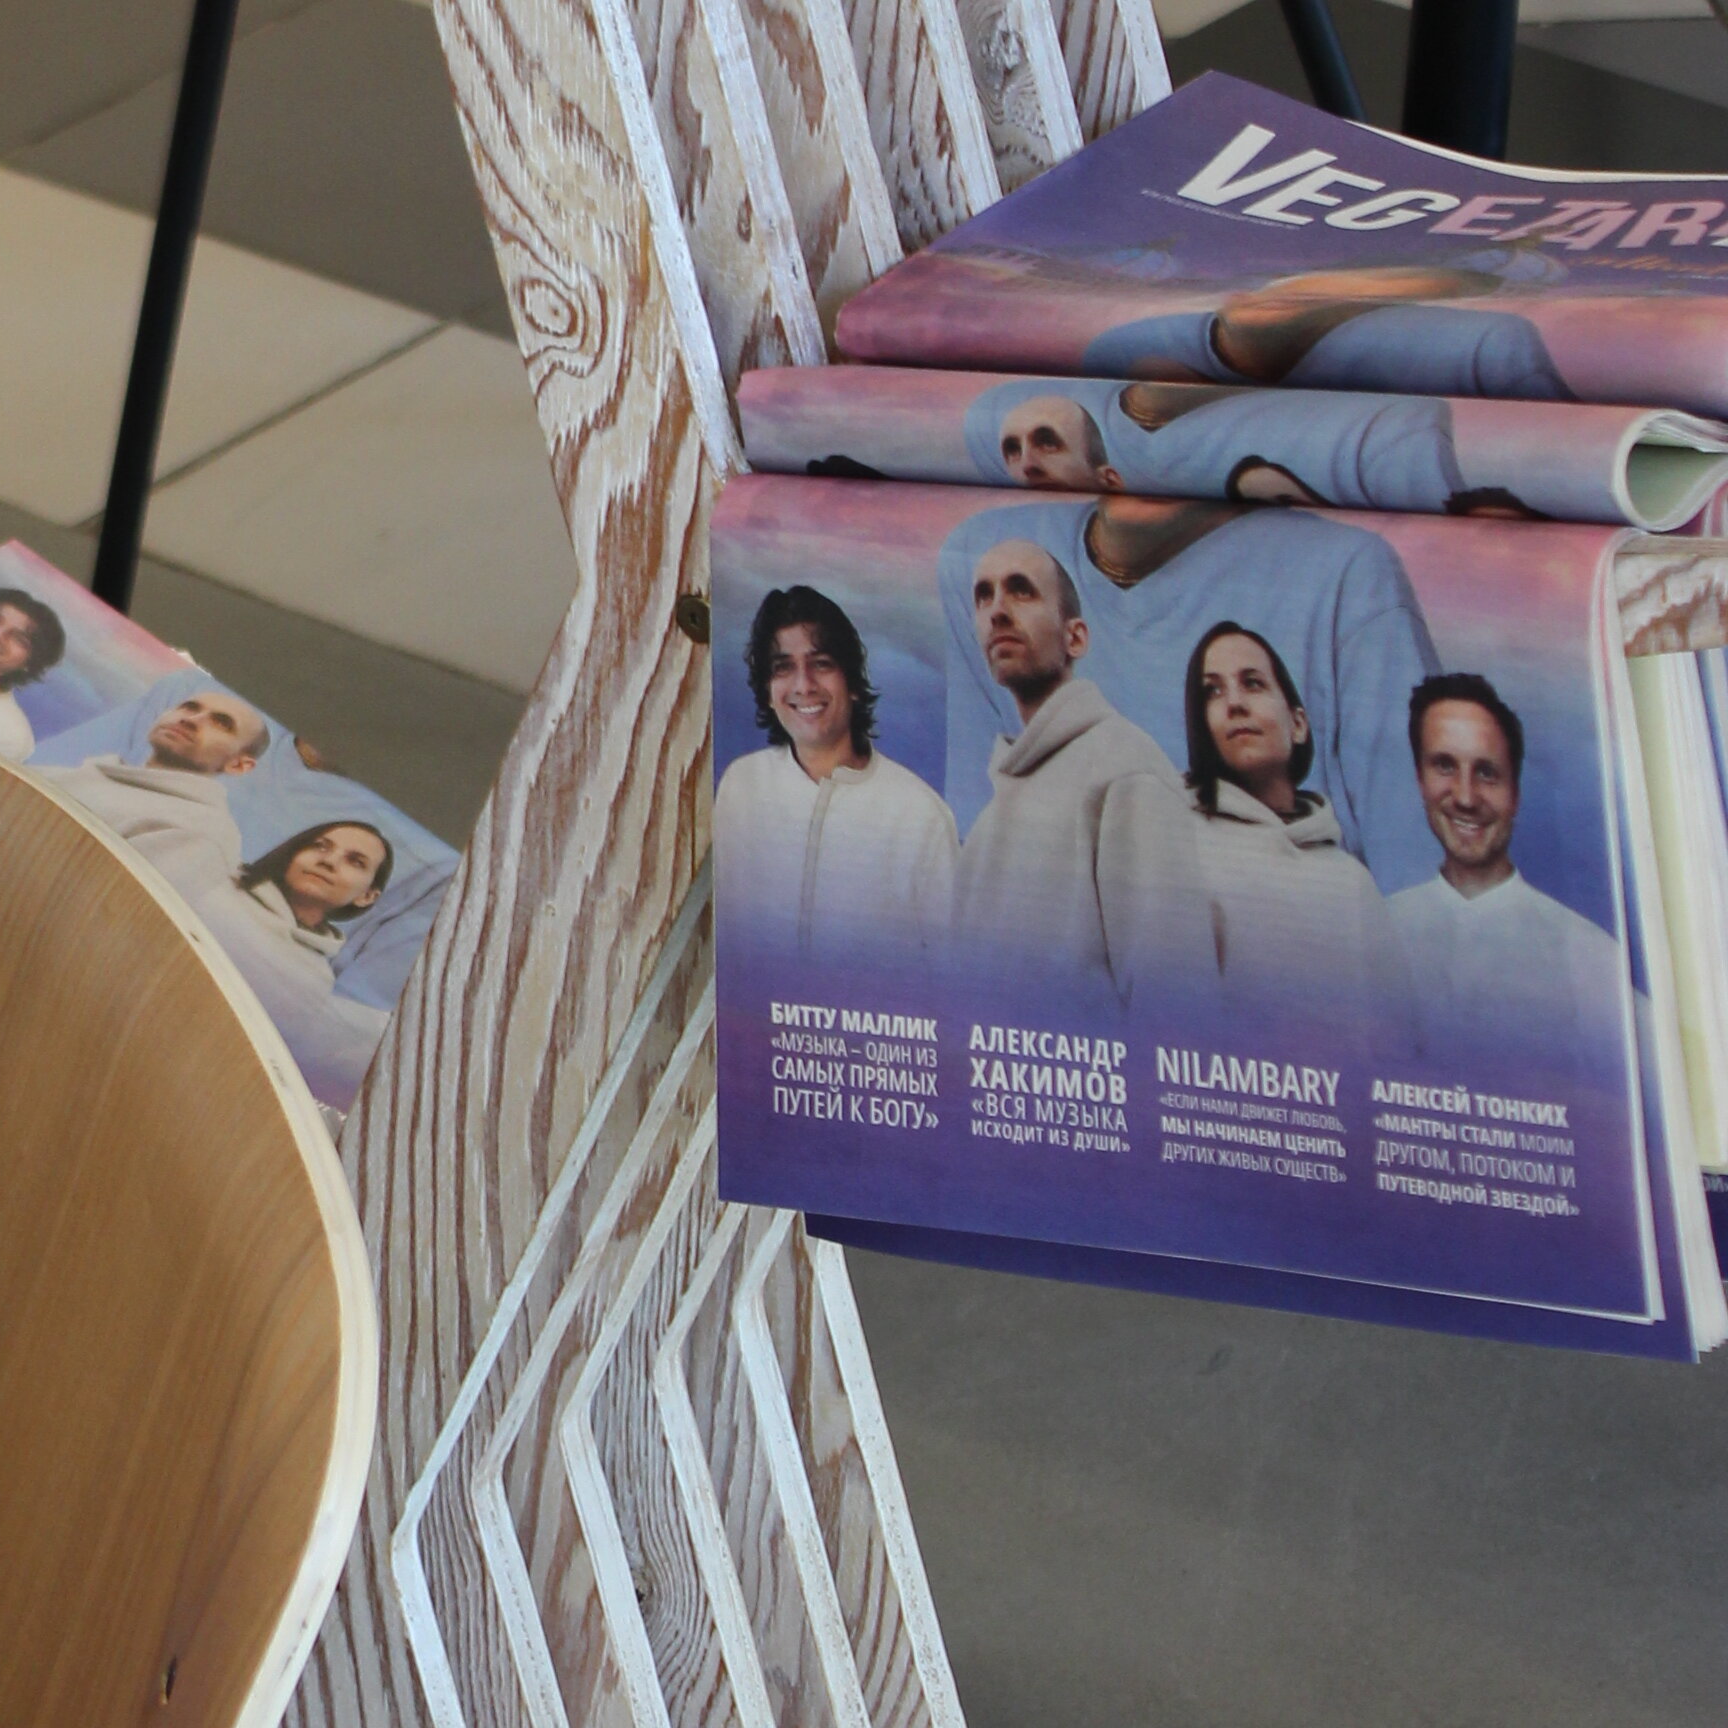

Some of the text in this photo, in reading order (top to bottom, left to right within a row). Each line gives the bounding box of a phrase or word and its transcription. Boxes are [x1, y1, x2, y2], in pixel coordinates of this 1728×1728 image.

[771, 1002, 939, 1042] БИТТУ МАЛЛИК
[771, 1032, 848, 1058] «МУЗЫКА
[865, 1042, 912, 1067] ОДИН
[916, 1047, 938, 1068] ИЗ
[970, 1025, 1128, 1072] АЛЕКСАНДР
[772, 1056, 939, 1098] САМЫХ ПРЯМЫХ
[970, 1058, 1128, 1105] ХАКИМОВ
[1156, 1046, 1341, 1107] NILAMBARY
[773, 1086, 940, 1129] ПУТЕЙ К БОГУ»
[972, 1094, 1129, 1133] «ВСЯ МУЗЫКА
[1201, 1097, 1238, 1117] НАМИ
[1241, 1102, 1289, 1125] ДВИЖЕТ
[1372, 1078, 1570, 1129] АЛЕКСЕЙ ТОНКИХ
[972, 1120, 1131, 1153] ИСХОДИТ ИЗ ДУШИ»
[1161, 1115, 1347, 1159] МЫ НАЧИНАЕМ ЦЕНИТЬ
[1161, 1140, 1216, 1166] ДРУГИХ
[1218, 1147, 1272, 1173] ЖИВЫХ
[1375, 1114, 1574, 1157] «МАНТРЫ СТАЛИ МОИМ
[1376, 1140, 1576, 1189] ДРУГОМ, ПОТОКОМ И
[1377, 1171, 1488, 1207] ПУТЕВОДНОЙ
